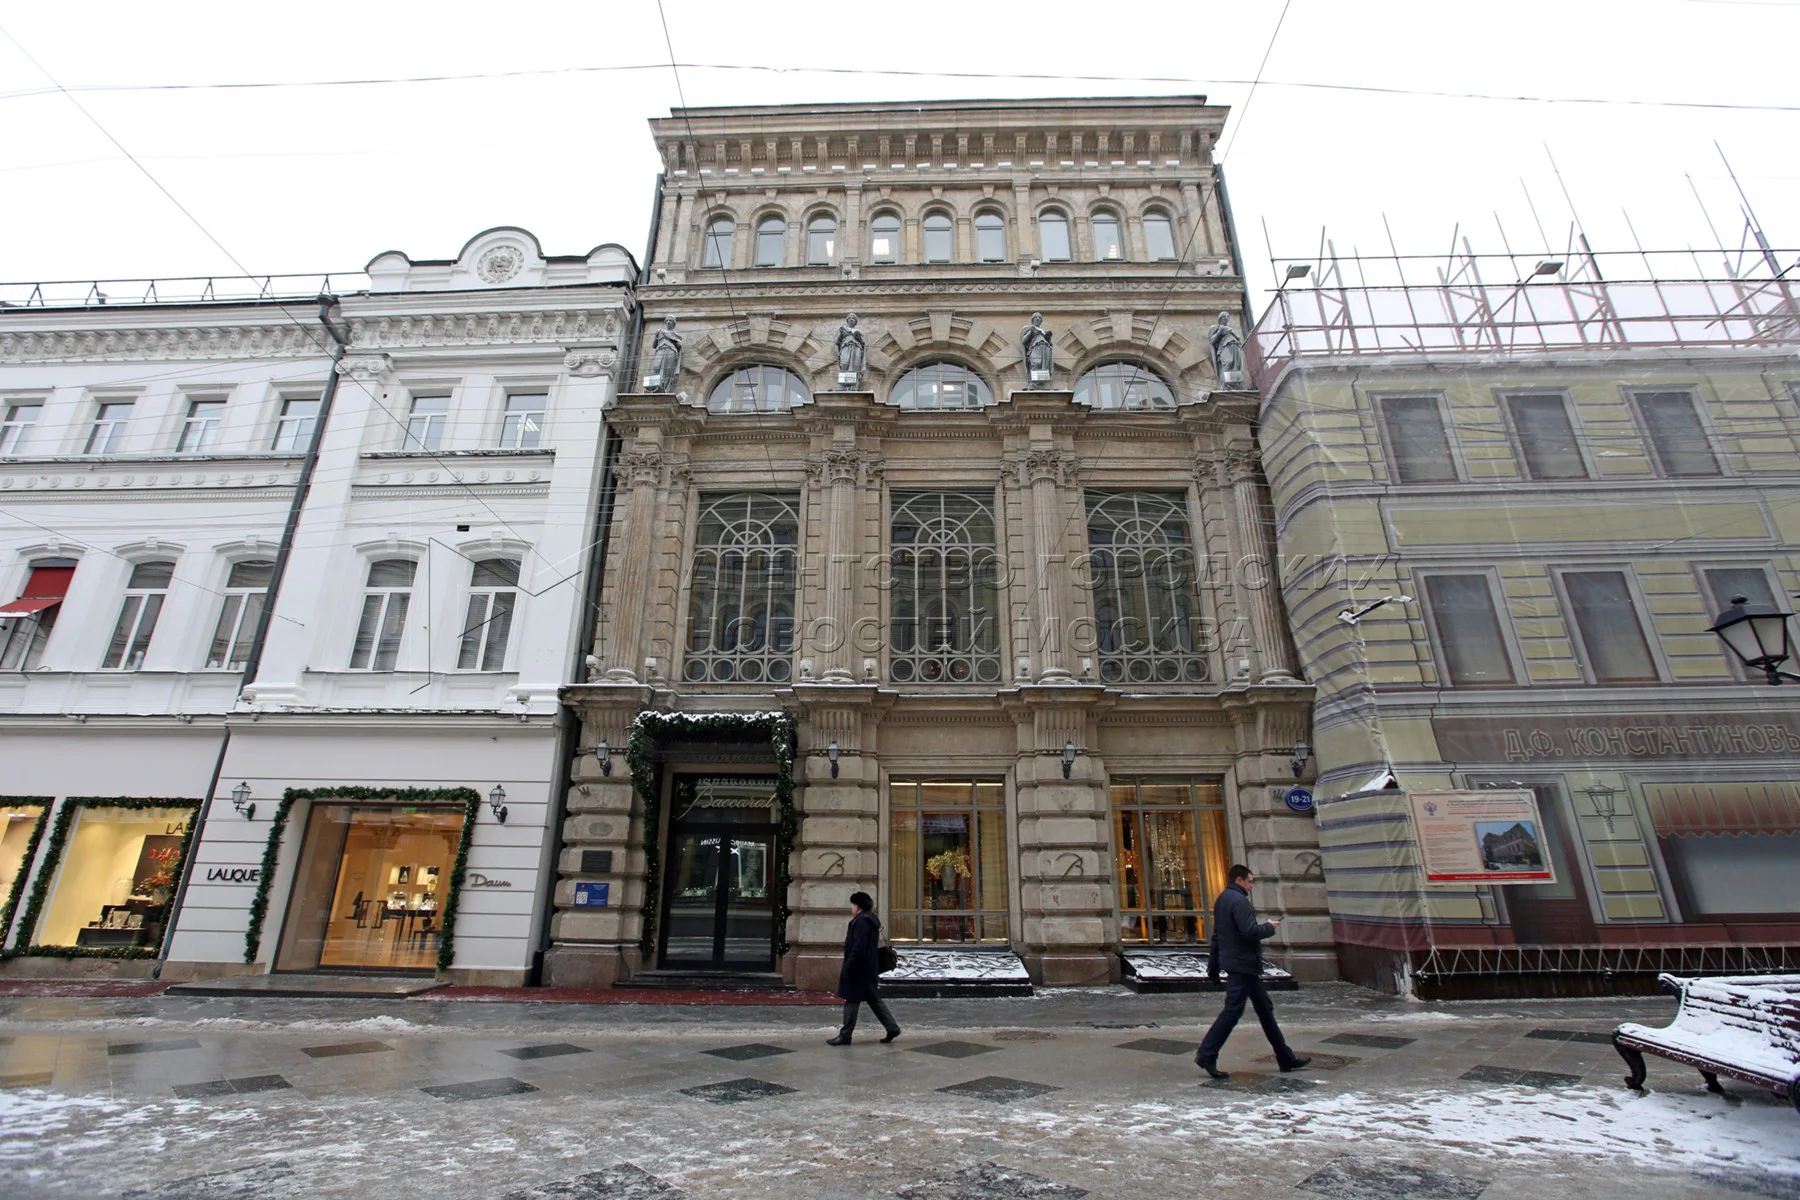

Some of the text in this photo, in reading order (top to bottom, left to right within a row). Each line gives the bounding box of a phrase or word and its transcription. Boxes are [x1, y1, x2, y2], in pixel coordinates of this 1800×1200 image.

[1503, 728, 1564, 762] Д.Ф.
[678, 780, 776, 820] Baccarat
[1290, 795, 1311, 804] 19-21
[207, 868, 260, 883] LALIQUE
